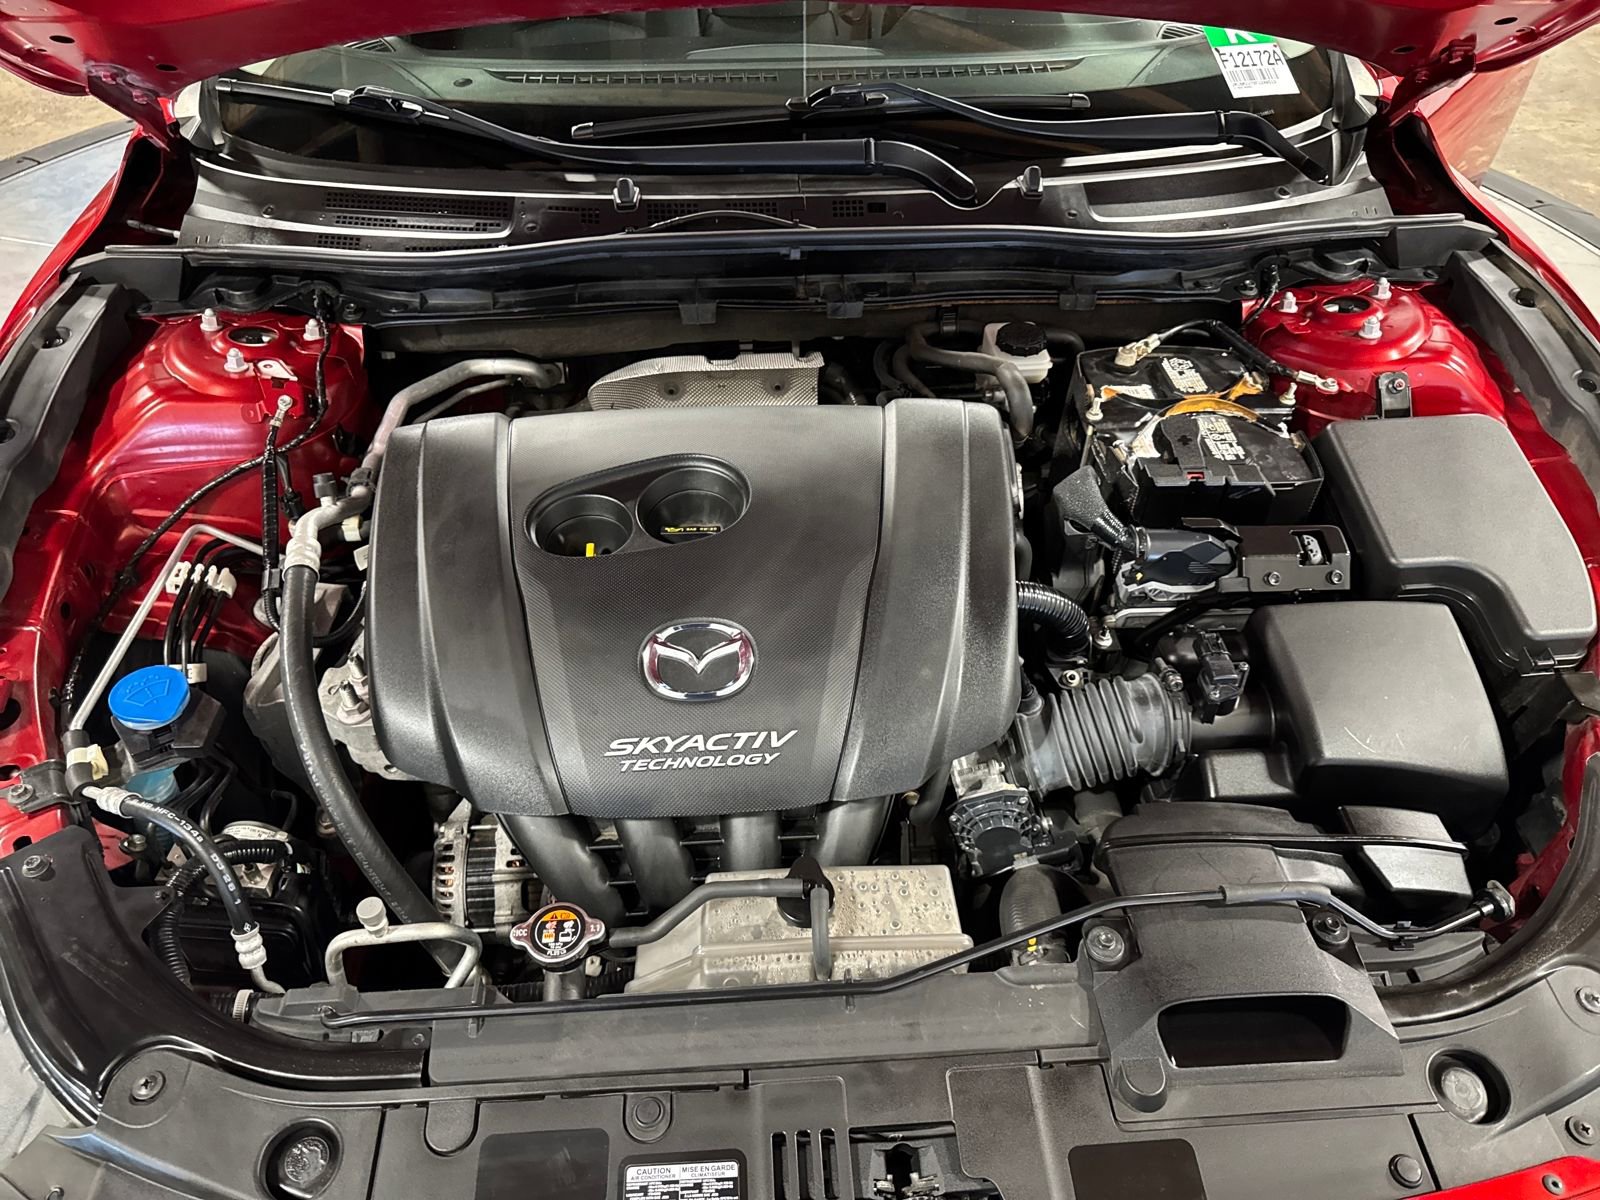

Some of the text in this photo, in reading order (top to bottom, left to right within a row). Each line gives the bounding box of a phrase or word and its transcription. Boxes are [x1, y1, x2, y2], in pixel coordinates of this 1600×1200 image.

[1219, 50, 1284, 69] F12172A
[604, 730, 799, 757] SKYACTIV
[620, 752, 781, 772] TECHNOLOGY
[636, 1167, 671, 1176] CAUTION
[682, 1165, 699, 1173] MISE
